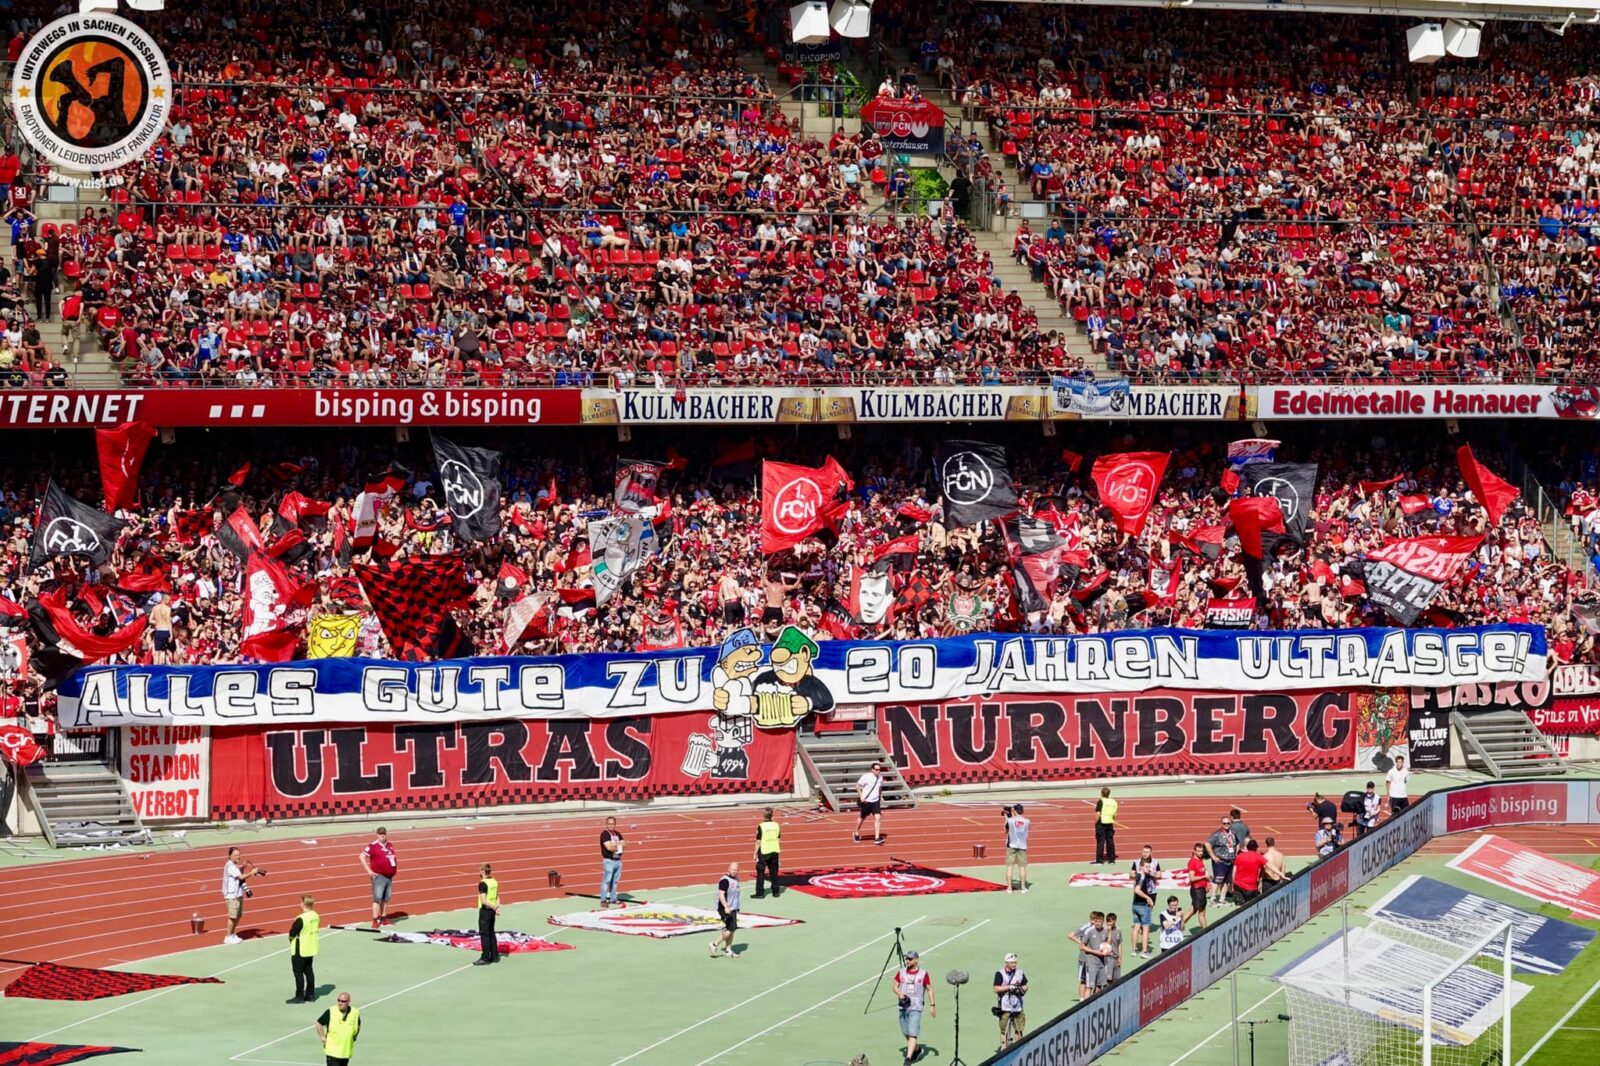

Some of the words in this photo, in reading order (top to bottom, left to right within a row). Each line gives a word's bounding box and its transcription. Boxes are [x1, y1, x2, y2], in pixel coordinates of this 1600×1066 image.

[893, 121, 911, 130] FCN
[14, 186, 27, 198] 30
[0, 394, 144, 424] TERNET
[315, 391, 413, 423] bisping
[420, 391, 440, 417] &
[446, 391, 541, 423] bisping
[623, 391, 774, 420] KULMBACHER
[860, 389, 1003, 418] KULMBACHER
[1273, 390, 1425, 415] Edelmetalle
[1433, 390, 1541, 415] Hanauer
[444, 479, 479, 506] FCN
[946, 470, 988, 493] FCN
[780, 500, 816, 519] FCN
[1207, 607, 1253, 621] FIASKO
[606, 655, 705, 709] ZU
[847, 645, 936, 694] 20
[884, 692, 1353, 770] NÜRNBERG
[1410, 729, 1429, 740] WILL
[1420, 718, 1436, 729] YOU
[54, 733, 101, 754] RIVALITÄT
[130, 754, 200, 783] STADION
[265, 717, 652, 798] ULTRAS
[721, 759, 744, 772] 1994
[131, 788, 199, 817] VERBOT
[1452, 800, 1487, 821] bisping
[1488, 798, 1498, 814] &
[1501, 796, 1558, 815] bisping
[1208, 888, 1298, 974] GLASFASER-AUSBAU
